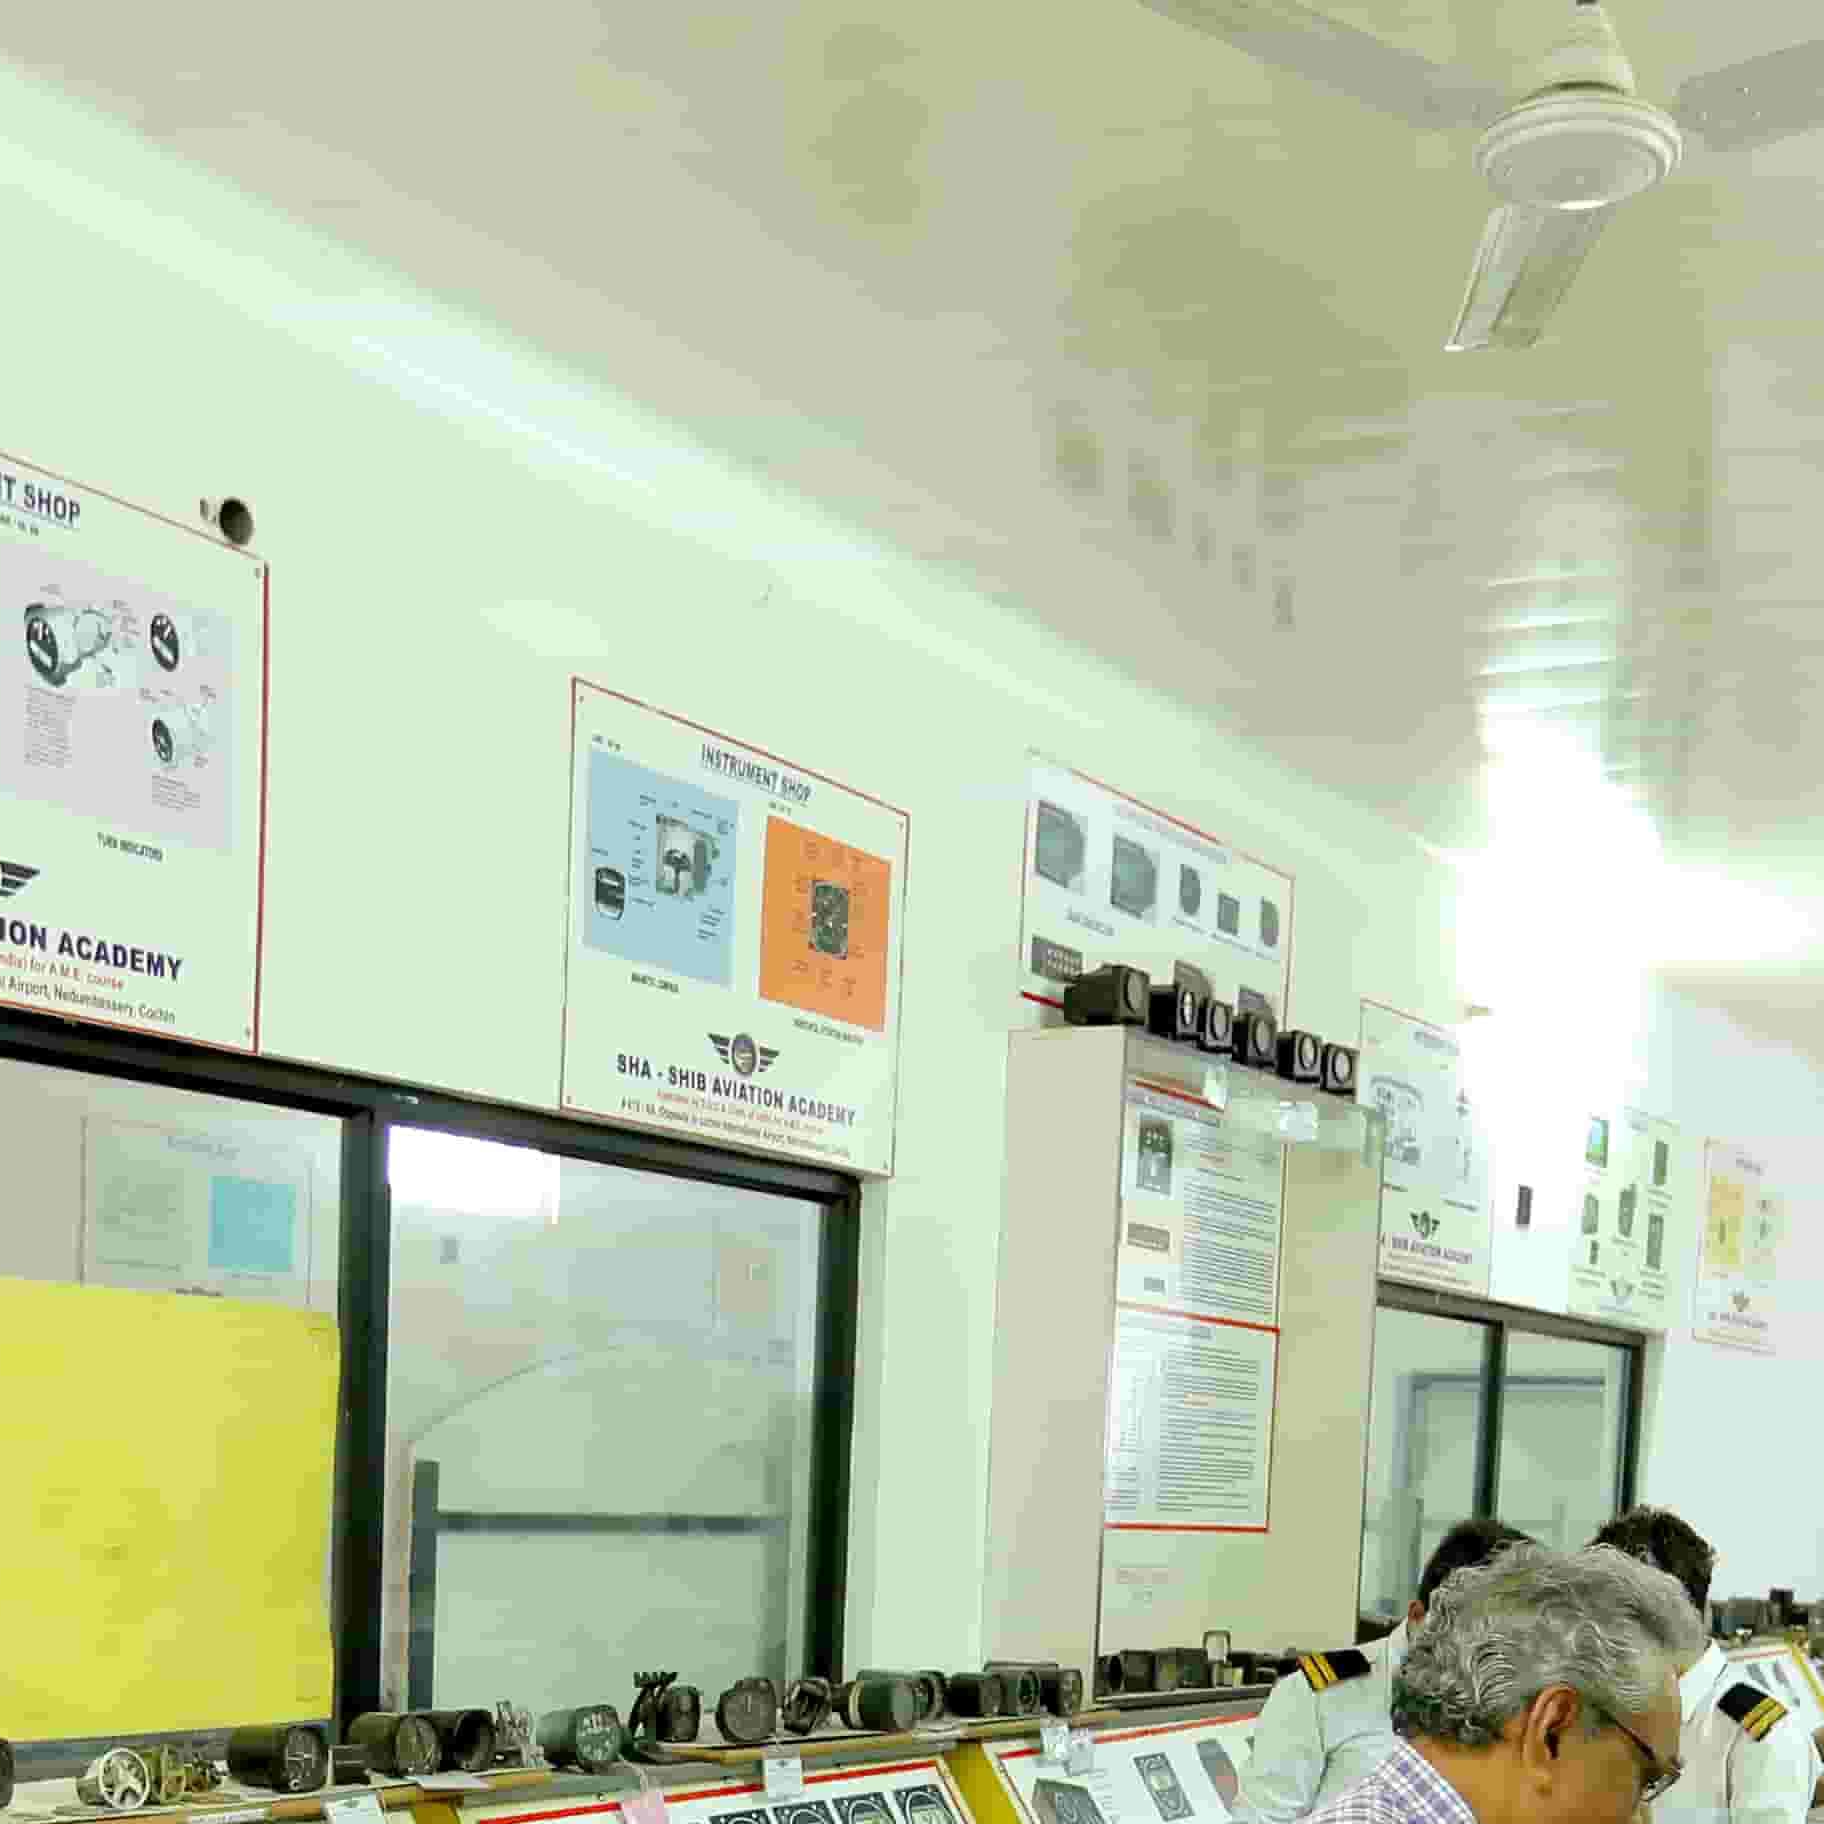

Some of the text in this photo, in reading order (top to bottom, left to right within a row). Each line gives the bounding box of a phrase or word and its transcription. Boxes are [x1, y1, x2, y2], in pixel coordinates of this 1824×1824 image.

[24, 483, 81, 524] SHOP
[702, 742, 778, 788] INSTRUMENT
[57, 931, 184, 982] ACADEMY
[9, 976, 51, 1001] Airport,
[617, 1053, 651, 1080] SHA
[668, 1065, 706, 1091] SHIB
[712, 1075, 784, 1108] AVIATION
[789, 1095, 856, 1127] ACADEMY
